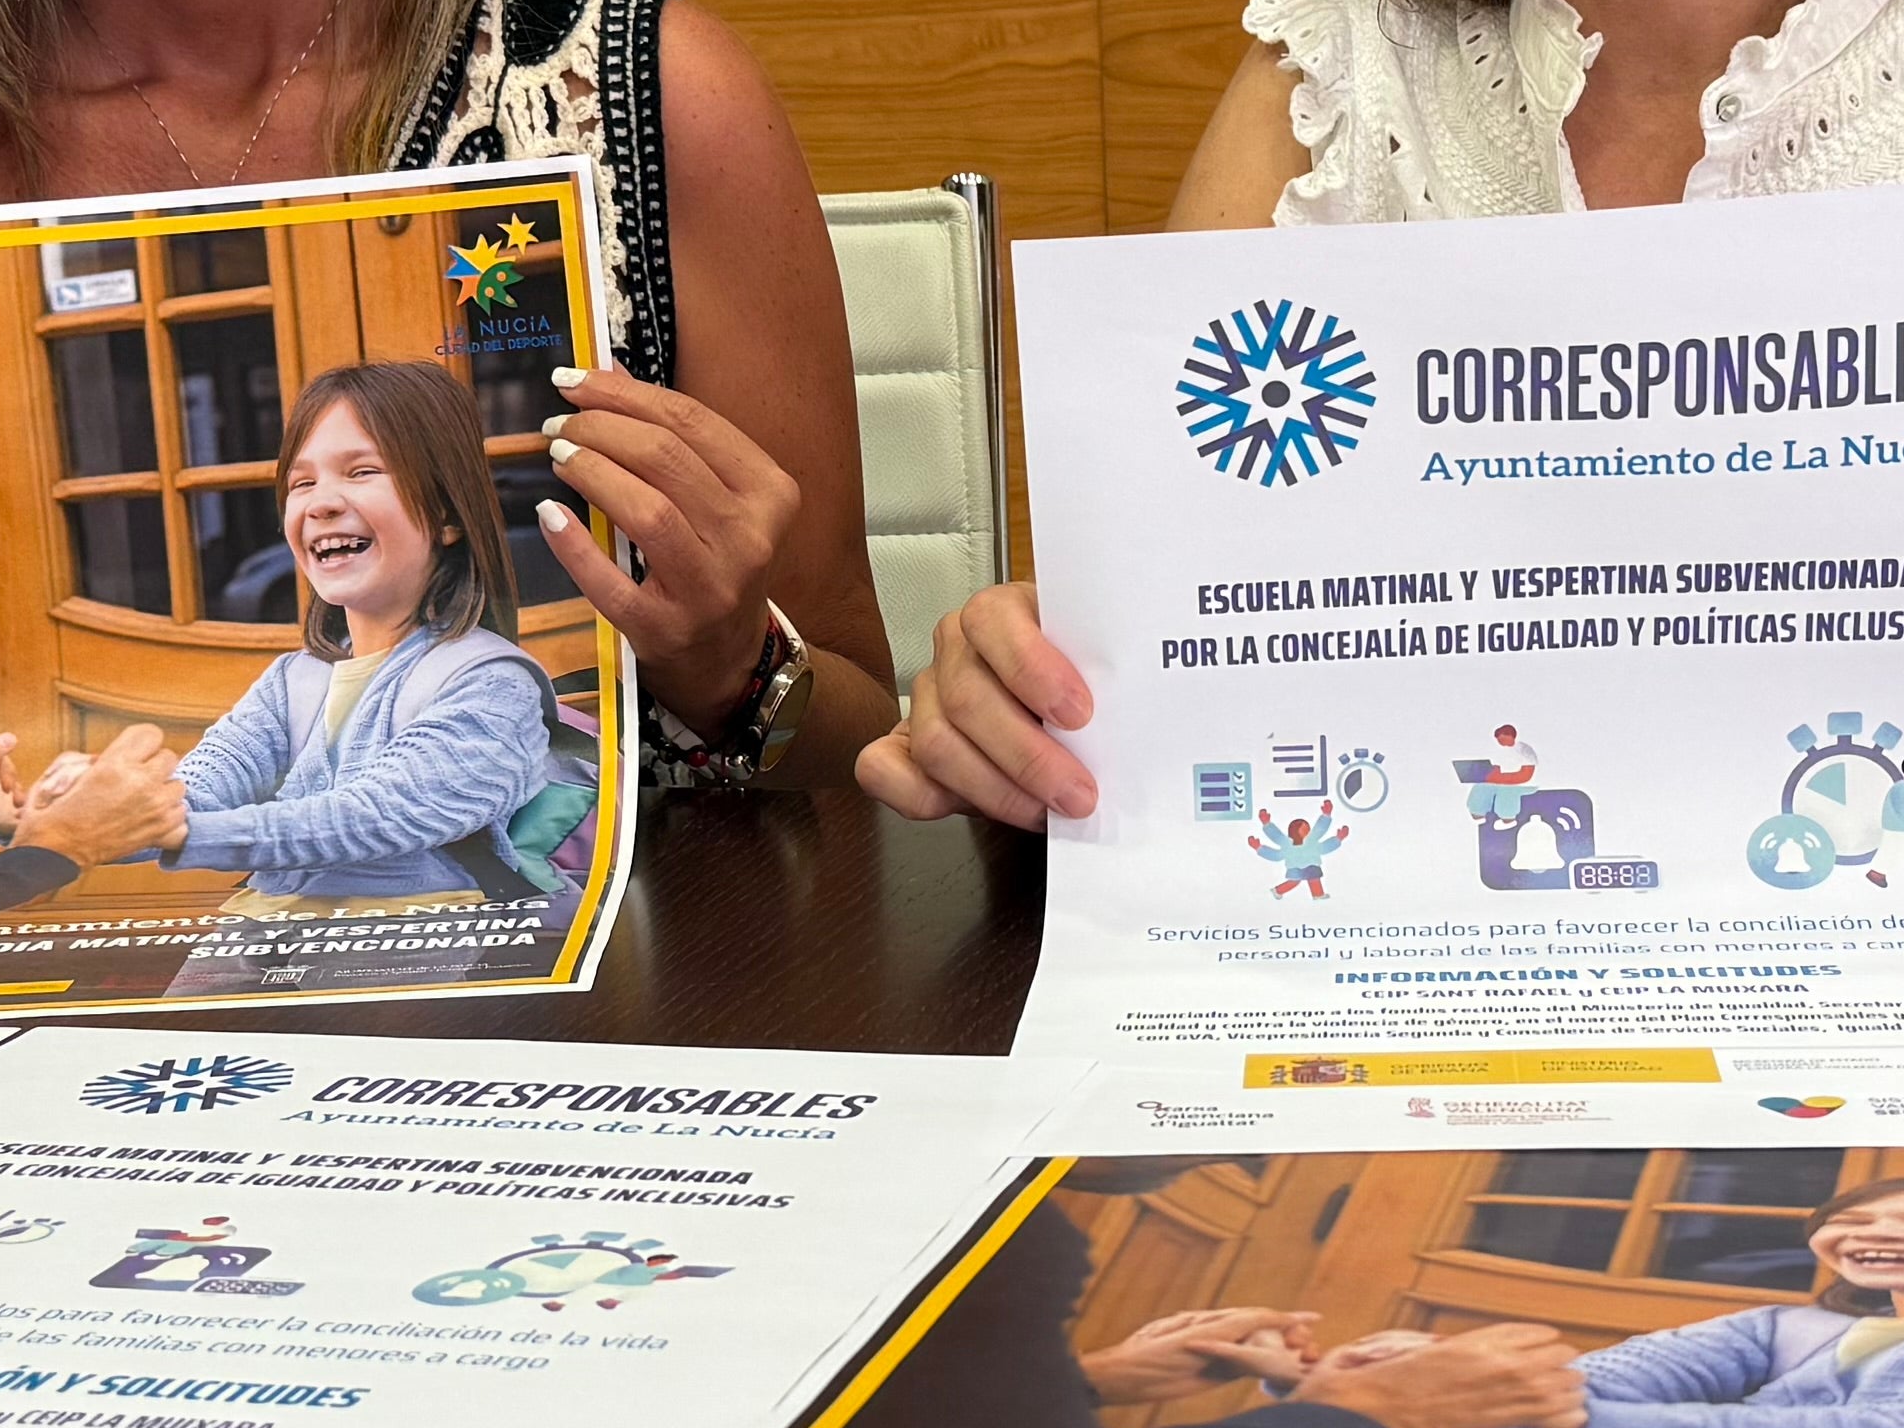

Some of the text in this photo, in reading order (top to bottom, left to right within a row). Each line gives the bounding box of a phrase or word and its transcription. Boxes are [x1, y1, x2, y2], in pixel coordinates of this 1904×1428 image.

[1420, 445, 1715, 484] Ayuntamiento
[1725, 441, 1772, 472] de
[1782, 439, 1829, 471] La
[1196, 579, 1316, 615] ESCUELA
[1321, 571, 1453, 608] MATINAL
[1458, 569, 1479, 601] Y
[1491, 563, 1668, 600] VESPERTINA
[1161, 637, 1218, 668] POR
[1225, 634, 1259, 666] LA
[1266, 620, 1427, 663] CONCEJALÍA
[1435, 623, 1469, 655] DE
[1477, 616, 1618, 654] IGUALDAD
[1626, 616, 1645, 646] Y
[1653, 608, 1796, 646] POLÍTICAS
[256, 909, 317, 923] de
[328, 907, 393, 920] La
[395, 899, 550, 917] Nucía
[1146, 926, 1259, 941] Servicios
[1267, 919, 1480, 940] Subvencionados
[1488, 922, 1546, 940] para
[1554, 918, 1679, 935] favorecer
[1686, 916, 1710, 933] la
[1718, 914, 1872, 932] conciliación
[68, 932, 245, 950] MATINAL
[264, 929, 291, 940] Y
[300, 916, 542, 938] VESPERTINA
[187, 933, 536, 959] SUBVENCIONADA
[1333, 964, 1842, 983] INFORMACIÓN Y SOLICITUDES
[1360, 983, 1809, 998] CEIP SANT RAFAEL y CEIP LA MUIXARA
[311, 1075, 878, 1119] CORRESPONSABLES
[279, 1109, 836, 1139] Ayuntamiento de La Nucía
[105, 1146, 253, 1164] MATINAL
[256, 1152, 285, 1165] Y
[289, 1153, 483, 1174] VESPERTINA
[482, 1160, 753, 1185] SUBVENCIONADA
[12, 1163, 194, 1184] CONCEJALÍA
[192, 1170, 244, 1185] DE
[237, 1172, 404, 1192] IGUALDAD
[406, 1178, 435, 1193] Y
[430, 1179, 599, 1200] POLÍTICAS
[598, 1187, 795, 1209] INCLUSIVAS
[55, 1372, 96, 1393] Y
[86, 1374, 371, 1408] SOLICITUDES
[15, 1408, 87, 1426] CEIP
[83, 1411, 126, 1428] LA
